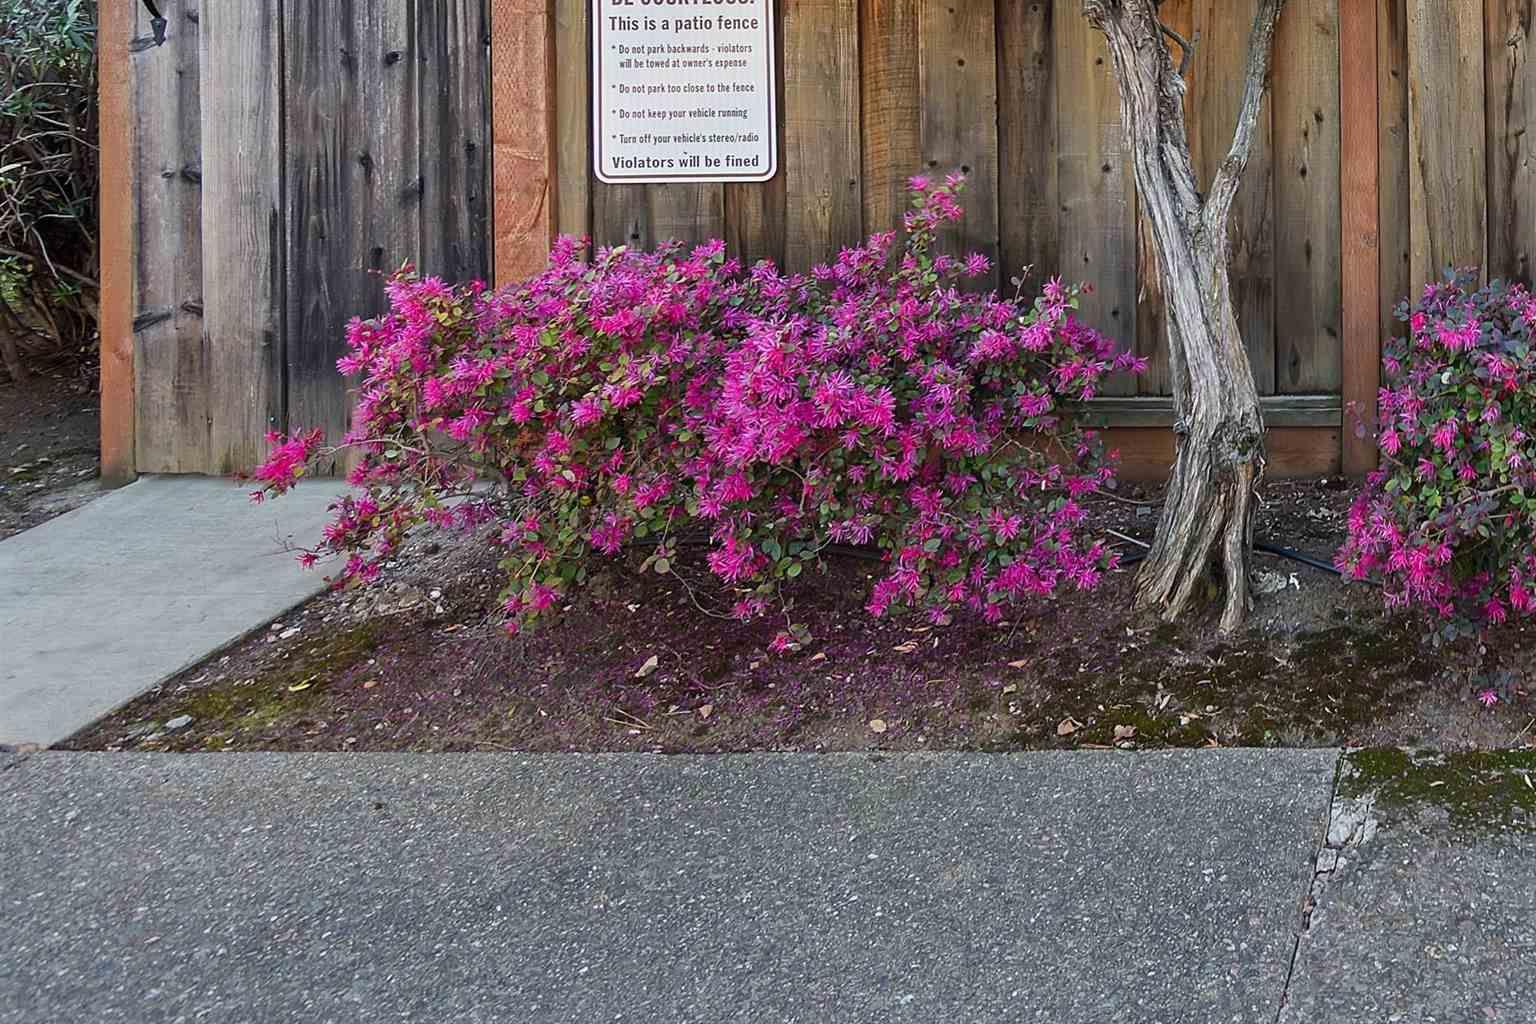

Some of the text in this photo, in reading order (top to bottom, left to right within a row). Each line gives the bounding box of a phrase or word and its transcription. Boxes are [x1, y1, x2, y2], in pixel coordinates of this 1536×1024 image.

[609, 15, 758, 33] This is a patio fence
[619, 45, 629, 54] Do
[632, 45, 644, 54] not
[648, 45, 665, 55] park
[667, 44, 709, 53] backwards
[717, 44, 752, 53] violators
[620, 59, 747, 69] will be towed at owner's expense
[619, 82, 754, 95] Do not park too close to the fence
[619, 108, 748, 120] Do not keep your vehicle running
[619, 132, 759, 145] Turn off your vehicle's stereo/radio
[612, 154, 759, 168] Violators will be fined
